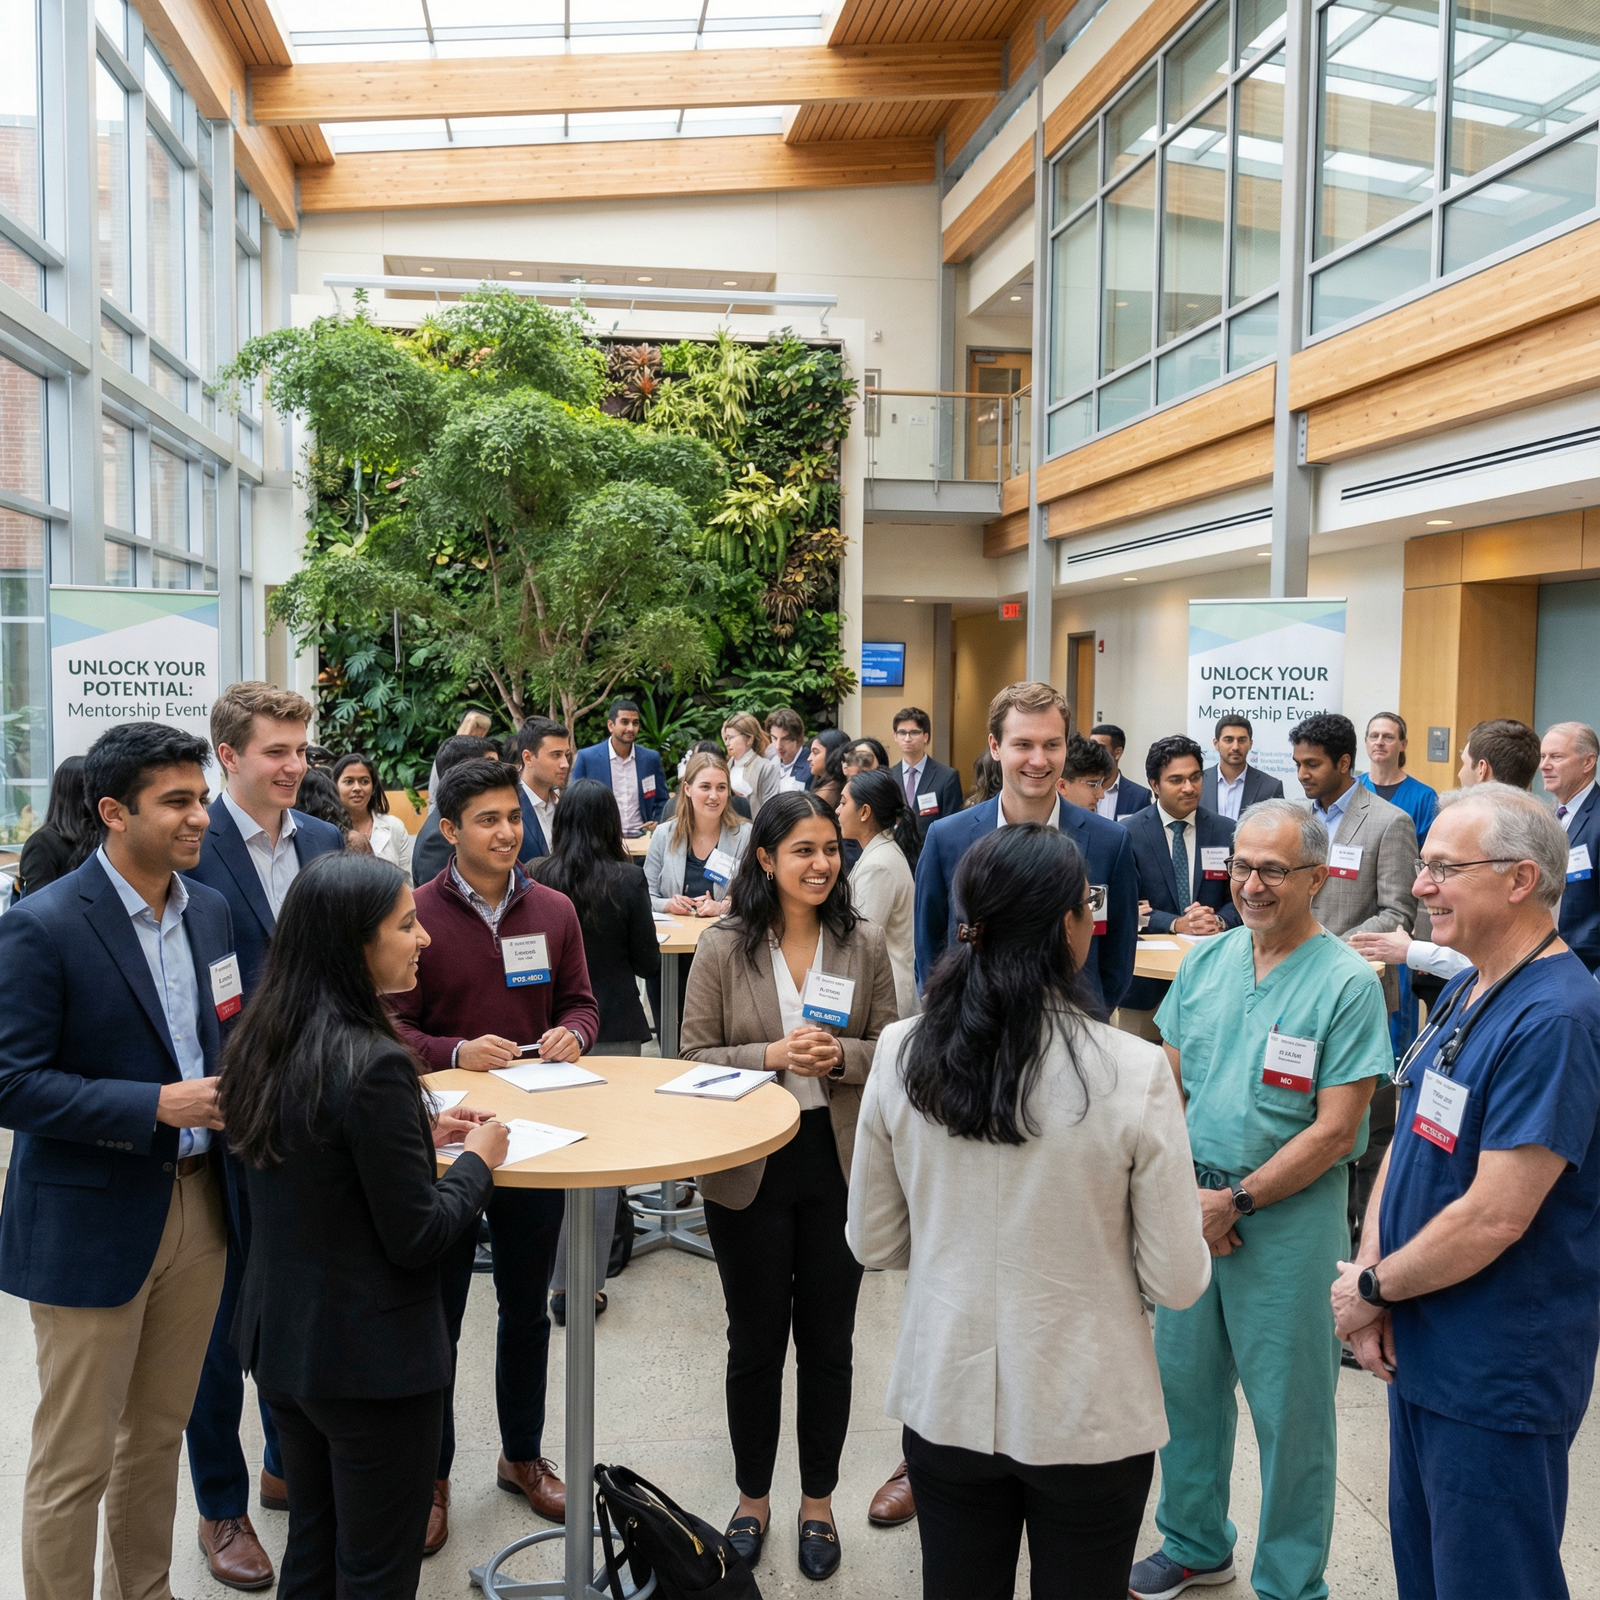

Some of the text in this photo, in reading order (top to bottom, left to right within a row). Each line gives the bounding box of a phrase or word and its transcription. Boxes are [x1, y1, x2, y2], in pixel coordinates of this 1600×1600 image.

[68, 660, 206, 677] UNLOCK YOUR
[1201, 666, 1328, 682] UNLOCK YOUR
[83, 681, 193, 697] POTENTIAL:
[1212, 686, 1314, 701] POTENTIAL:
[68, 702, 208, 720] Mentorship Event
[1198, 705, 1282, 723] Mentorship
